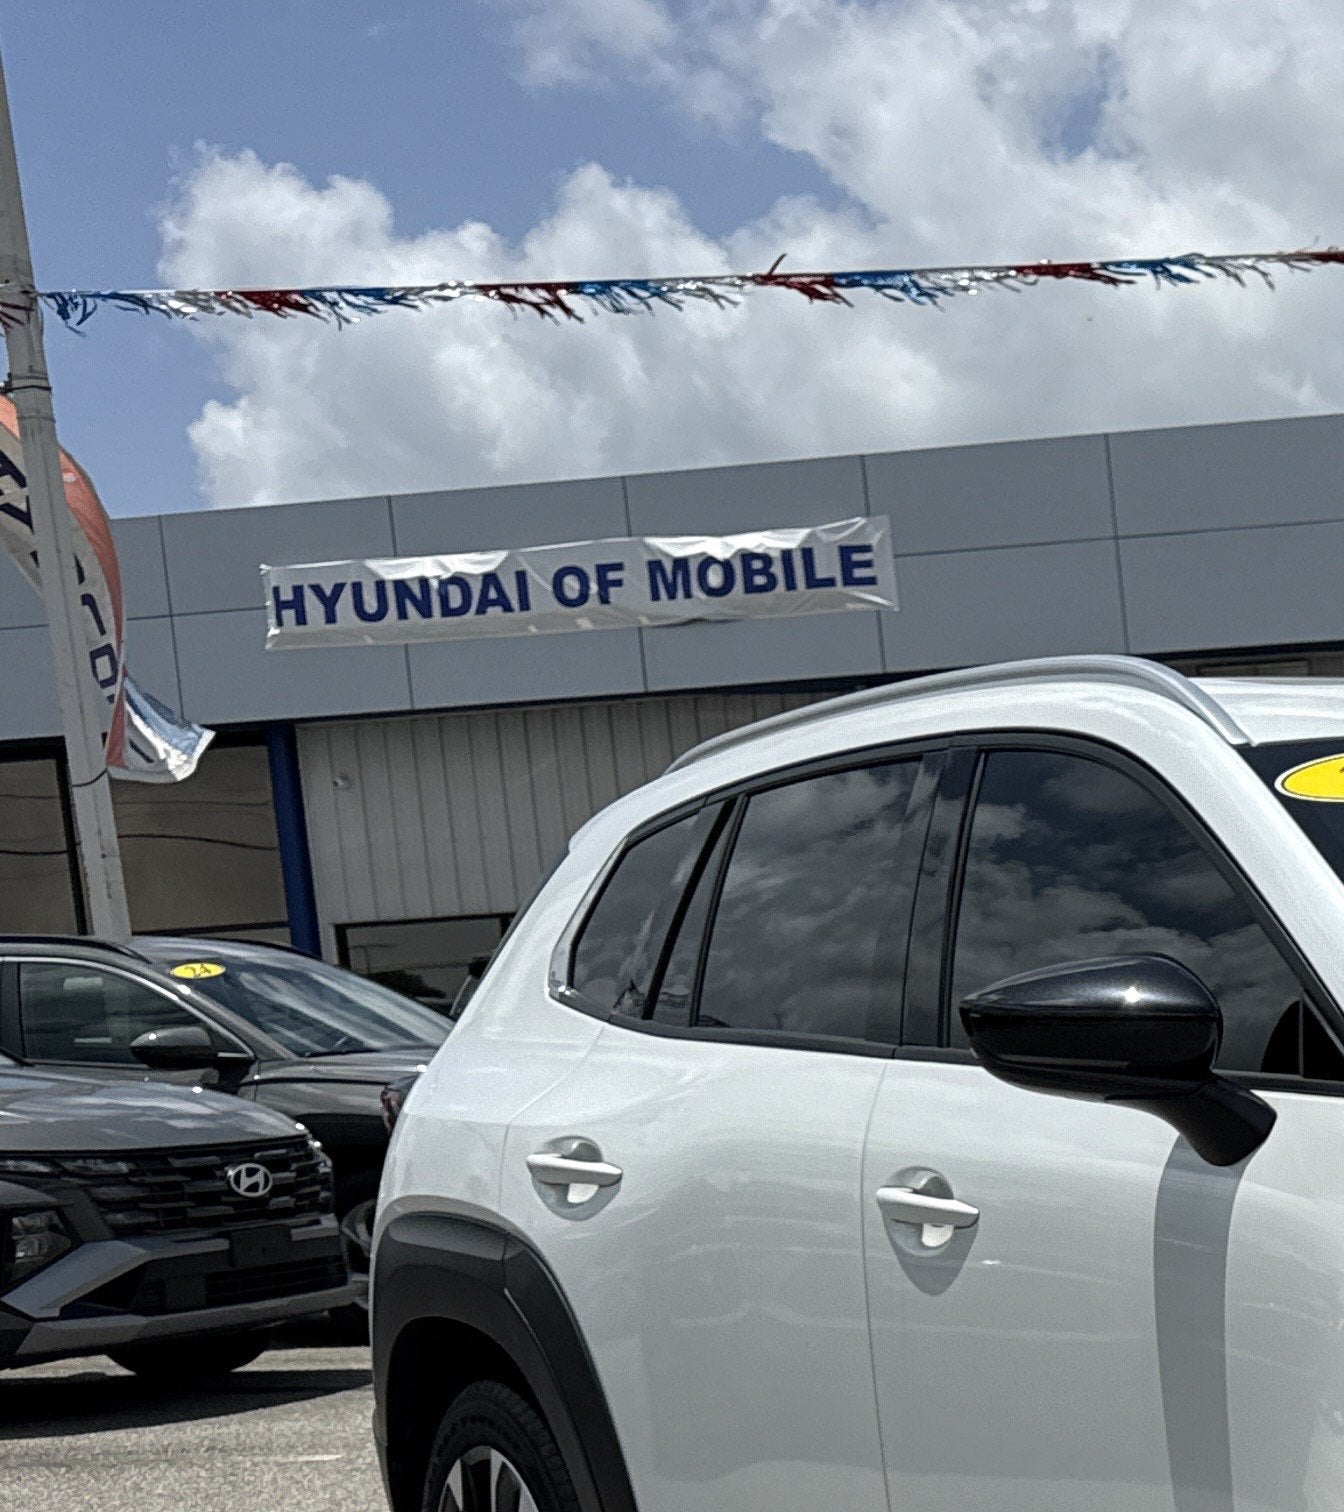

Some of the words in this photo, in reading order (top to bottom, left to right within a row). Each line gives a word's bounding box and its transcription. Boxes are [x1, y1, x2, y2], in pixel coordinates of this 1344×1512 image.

[272, 569, 531, 626] HYUNDAI
[552, 561, 625, 608] OF
[647, 544, 879, 601] MOBILE
